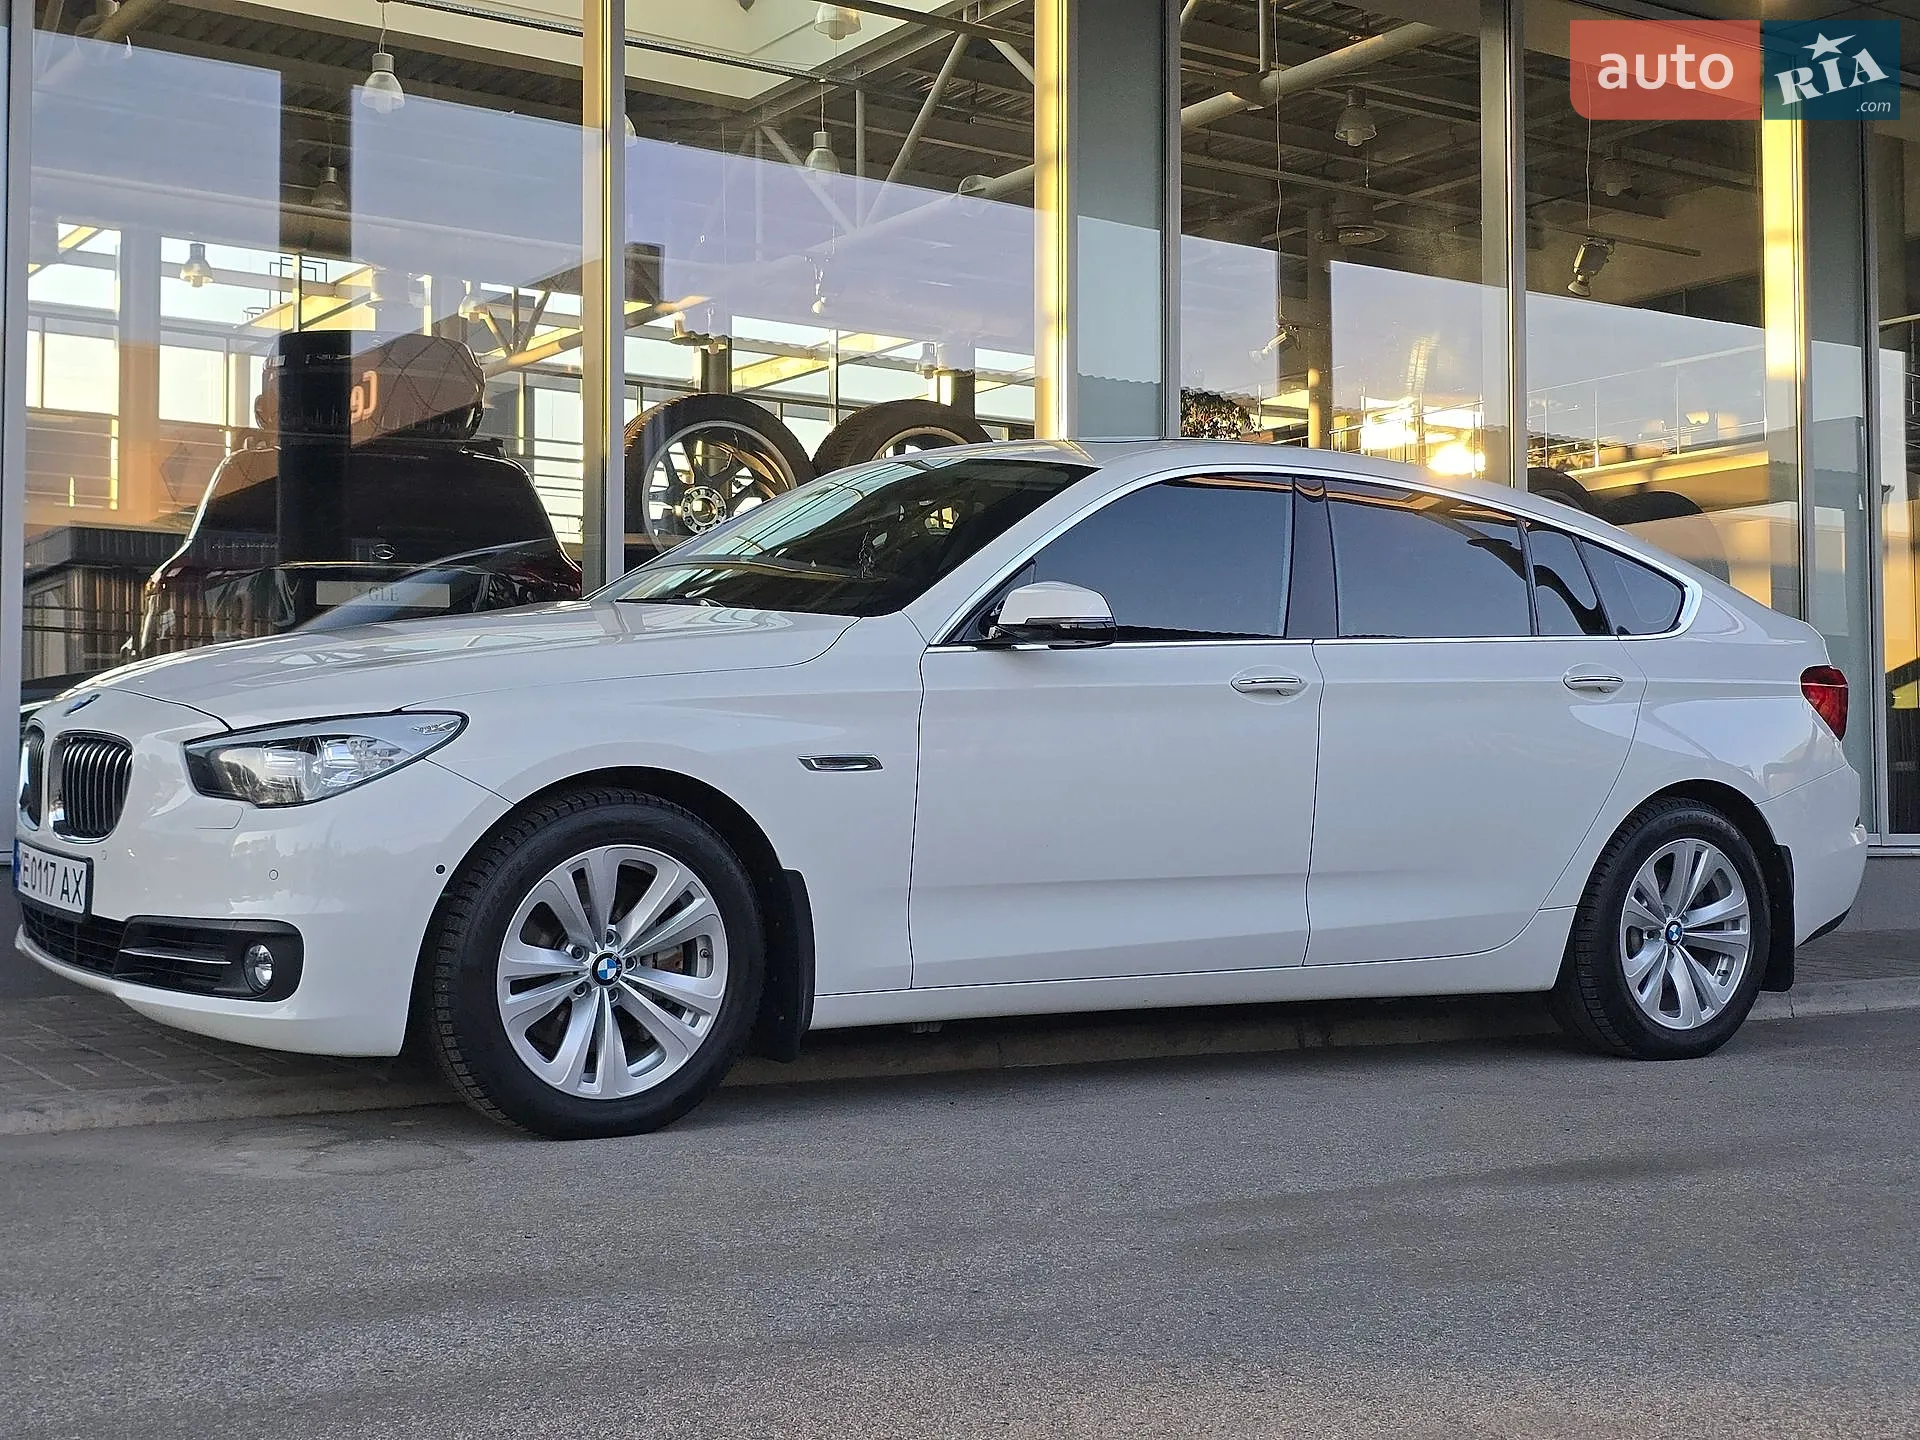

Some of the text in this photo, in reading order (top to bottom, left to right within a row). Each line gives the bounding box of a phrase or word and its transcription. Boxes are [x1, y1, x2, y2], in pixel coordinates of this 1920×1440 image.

[368, 586, 400, 602] GLE
[20, 850, 84, 906] E0117 AX
